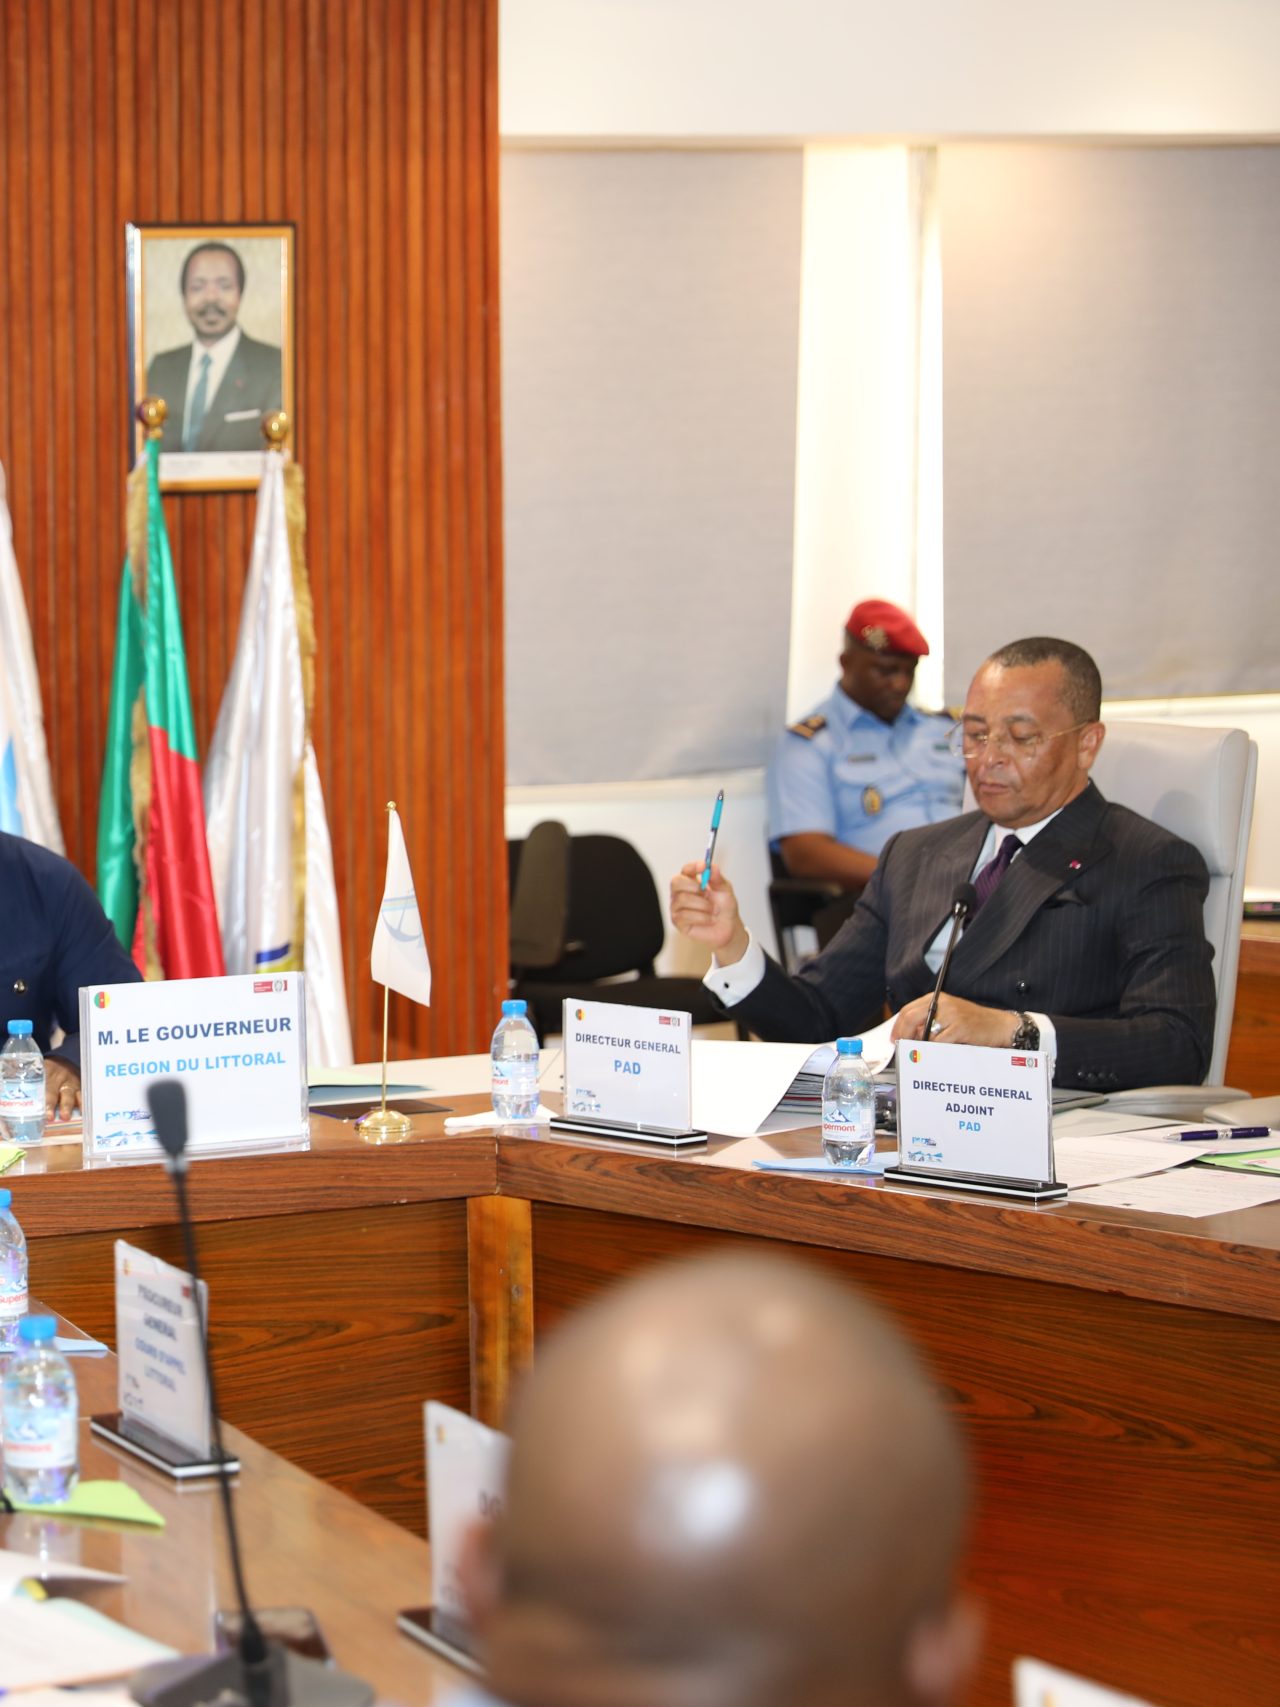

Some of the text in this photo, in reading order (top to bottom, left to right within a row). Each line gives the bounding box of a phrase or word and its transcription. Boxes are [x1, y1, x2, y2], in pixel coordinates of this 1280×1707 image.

[98, 1017, 292, 1045] M. LE GOUVERNEUR
[575, 1032, 681, 1054] DIRECTEUR GENERAL
[105, 1051, 286, 1077] REGION DU LITTORAL
[614, 1060, 641, 1075] PAD
[912, 1080, 1033, 1101] DIRECTEUR GENERAL
[945, 1102, 995, 1116] ADJOINT
[959, 1120, 982, 1132] PAD
